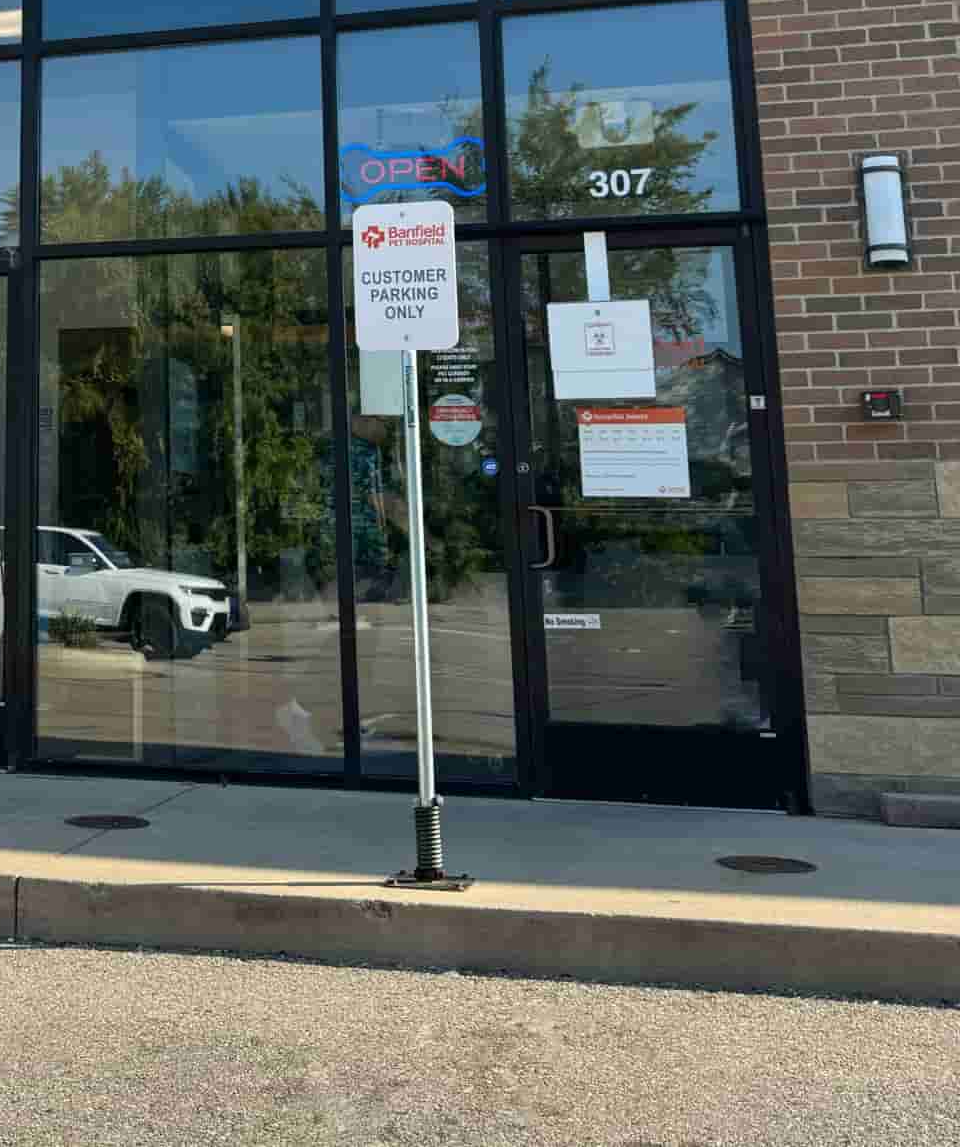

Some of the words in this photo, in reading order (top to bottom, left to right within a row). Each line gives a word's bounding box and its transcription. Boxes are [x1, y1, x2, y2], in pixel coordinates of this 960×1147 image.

[359, 155, 466, 184] OPEN
[589, 167, 653, 198] 307
[388, 224, 446, 238] Banfield
[361, 268, 447, 286] CUSTOMER
[370, 286, 439, 303] PARKING
[384, 305, 425, 320] ONLY
